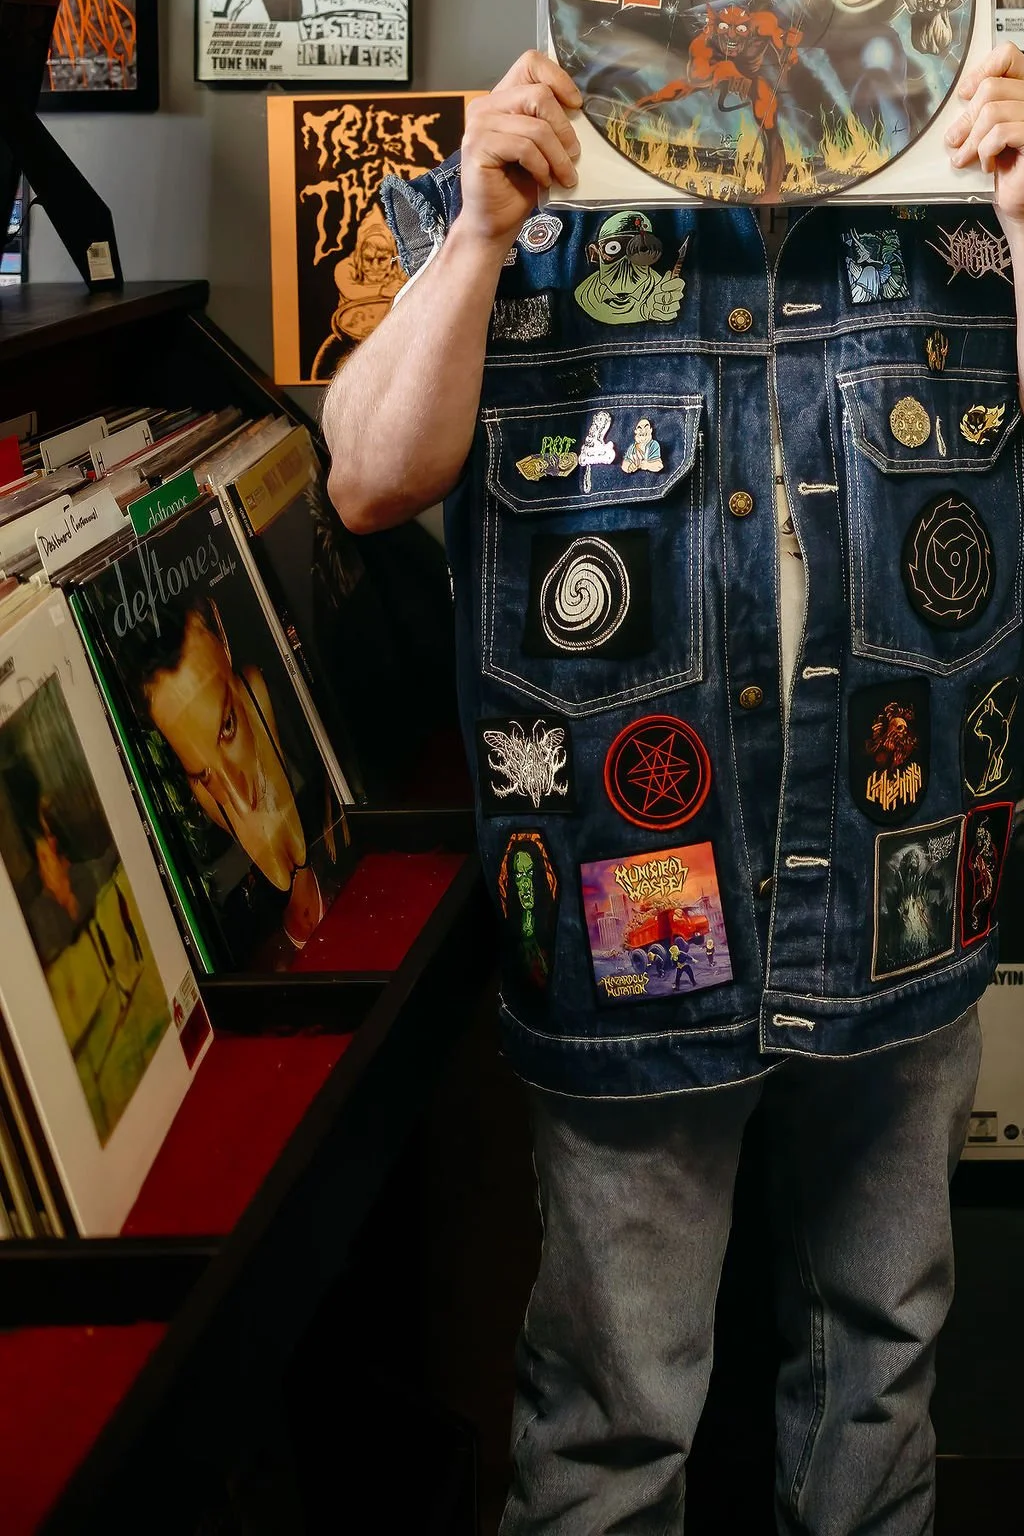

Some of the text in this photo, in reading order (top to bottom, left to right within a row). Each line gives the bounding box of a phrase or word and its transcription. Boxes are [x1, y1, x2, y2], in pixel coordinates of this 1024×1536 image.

[211, 57, 242, 70] TUNE
[245, 57, 267, 70] INN
[324, 44, 352, 66] MY
[358, 44, 403, 66] EYES
[302, 104, 445, 172] TRICK
[113, 534, 220, 638] deftones
[614, 855, 690, 886] MUNICIPAL
[615, 875, 685, 903] WASTE
[600, 972, 650, 990] HAZARDOUS
[606, 984, 648, 998] MUTATION
